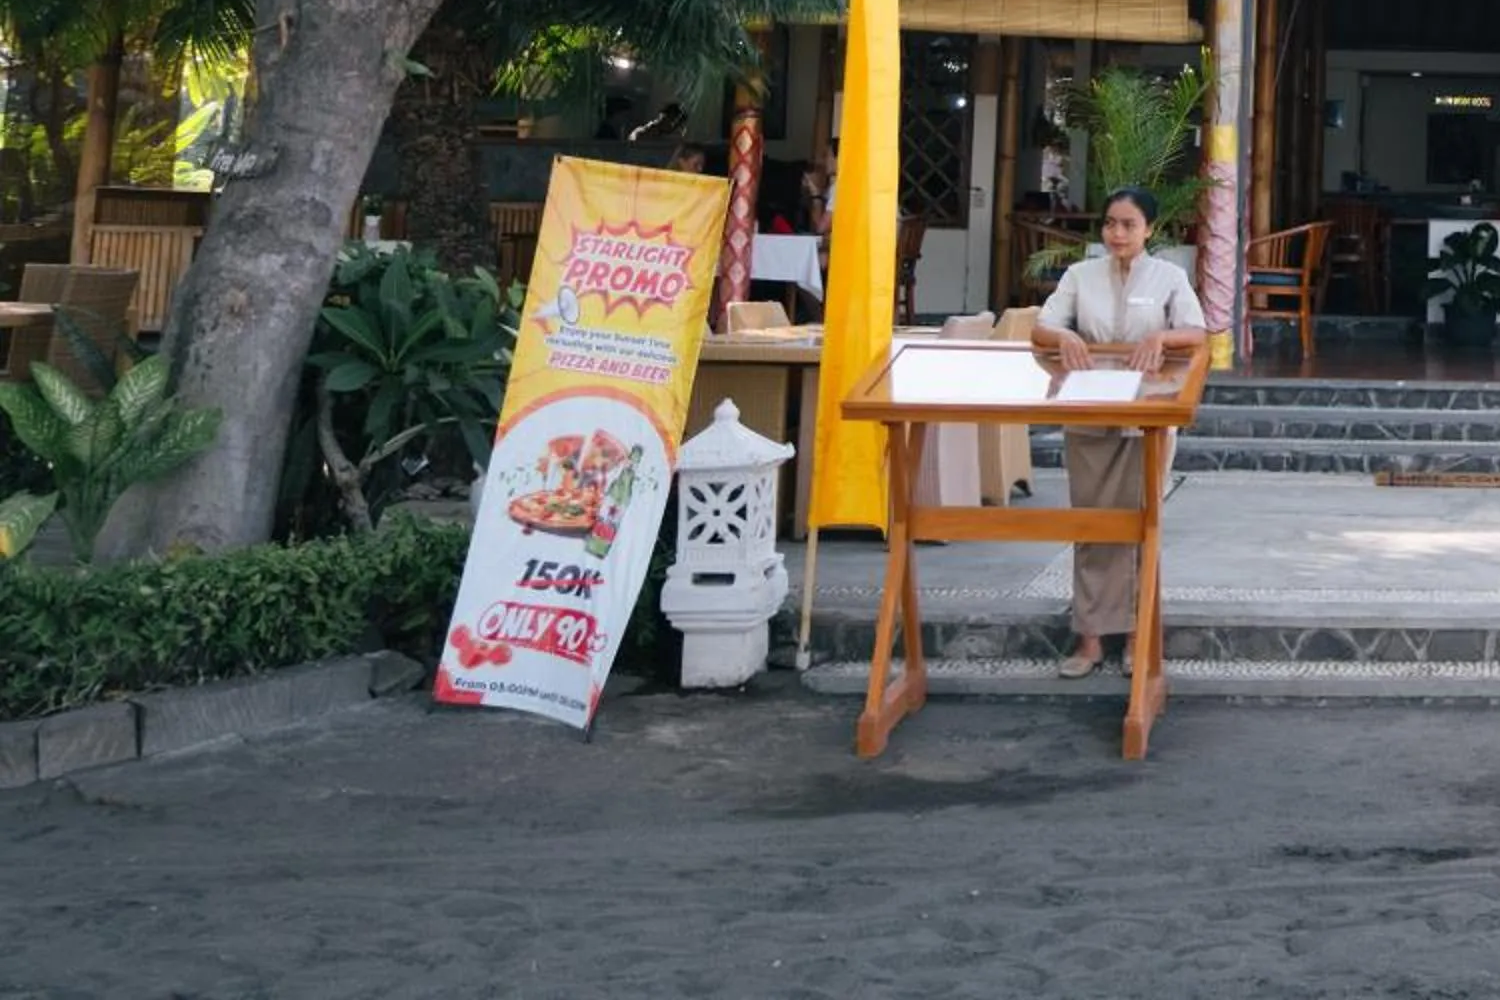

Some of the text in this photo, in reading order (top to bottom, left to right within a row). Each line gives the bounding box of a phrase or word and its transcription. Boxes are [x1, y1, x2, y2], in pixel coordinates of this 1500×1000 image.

[575, 236, 686, 267] STARLIGHT
[563, 258, 686, 299] PROMO
[595, 343, 617, 354] with
[550, 351, 671, 380] PIZZA AND BEER
[478, 600, 556, 641] ONLY
[455, 677, 487, 690] From
